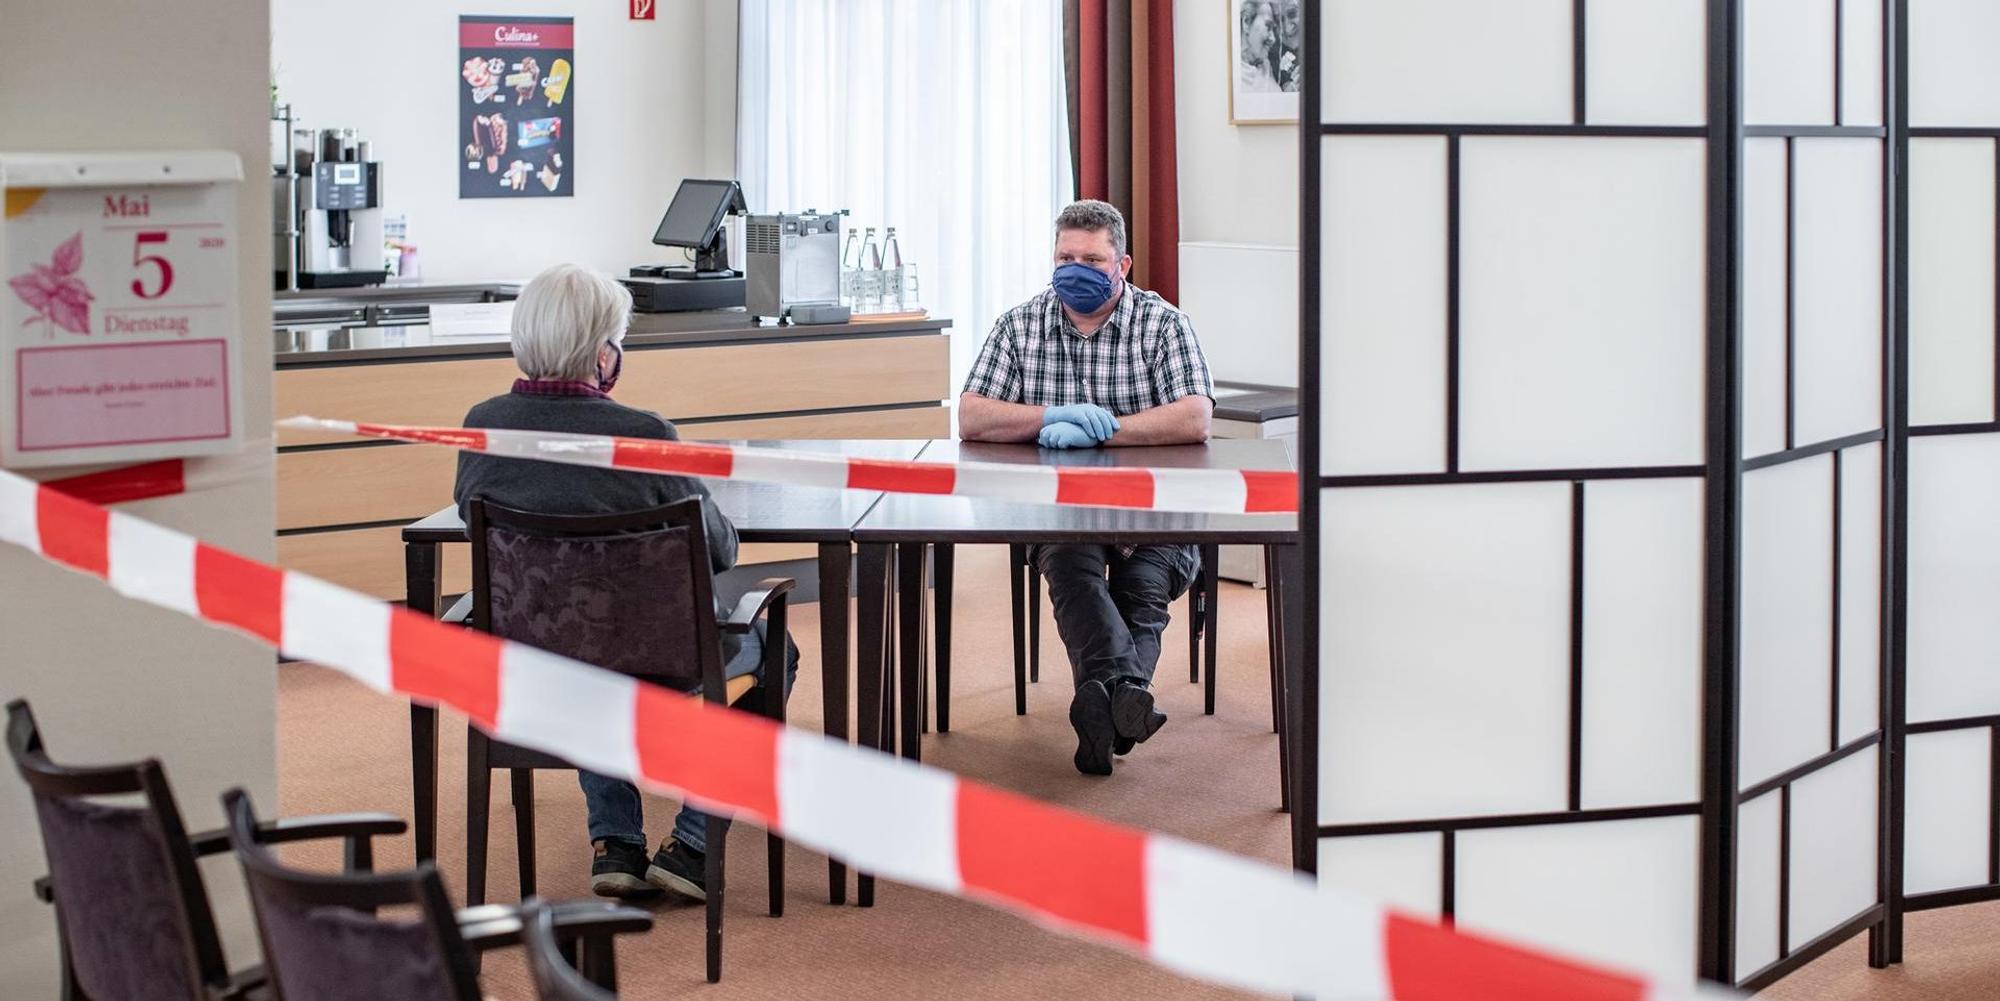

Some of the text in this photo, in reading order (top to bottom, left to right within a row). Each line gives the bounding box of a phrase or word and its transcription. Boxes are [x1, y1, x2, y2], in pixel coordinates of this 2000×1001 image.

[103, 195, 149, 218] Mai
[131, 231, 174, 300] 5
[104, 315, 189, 335] Dienstag
